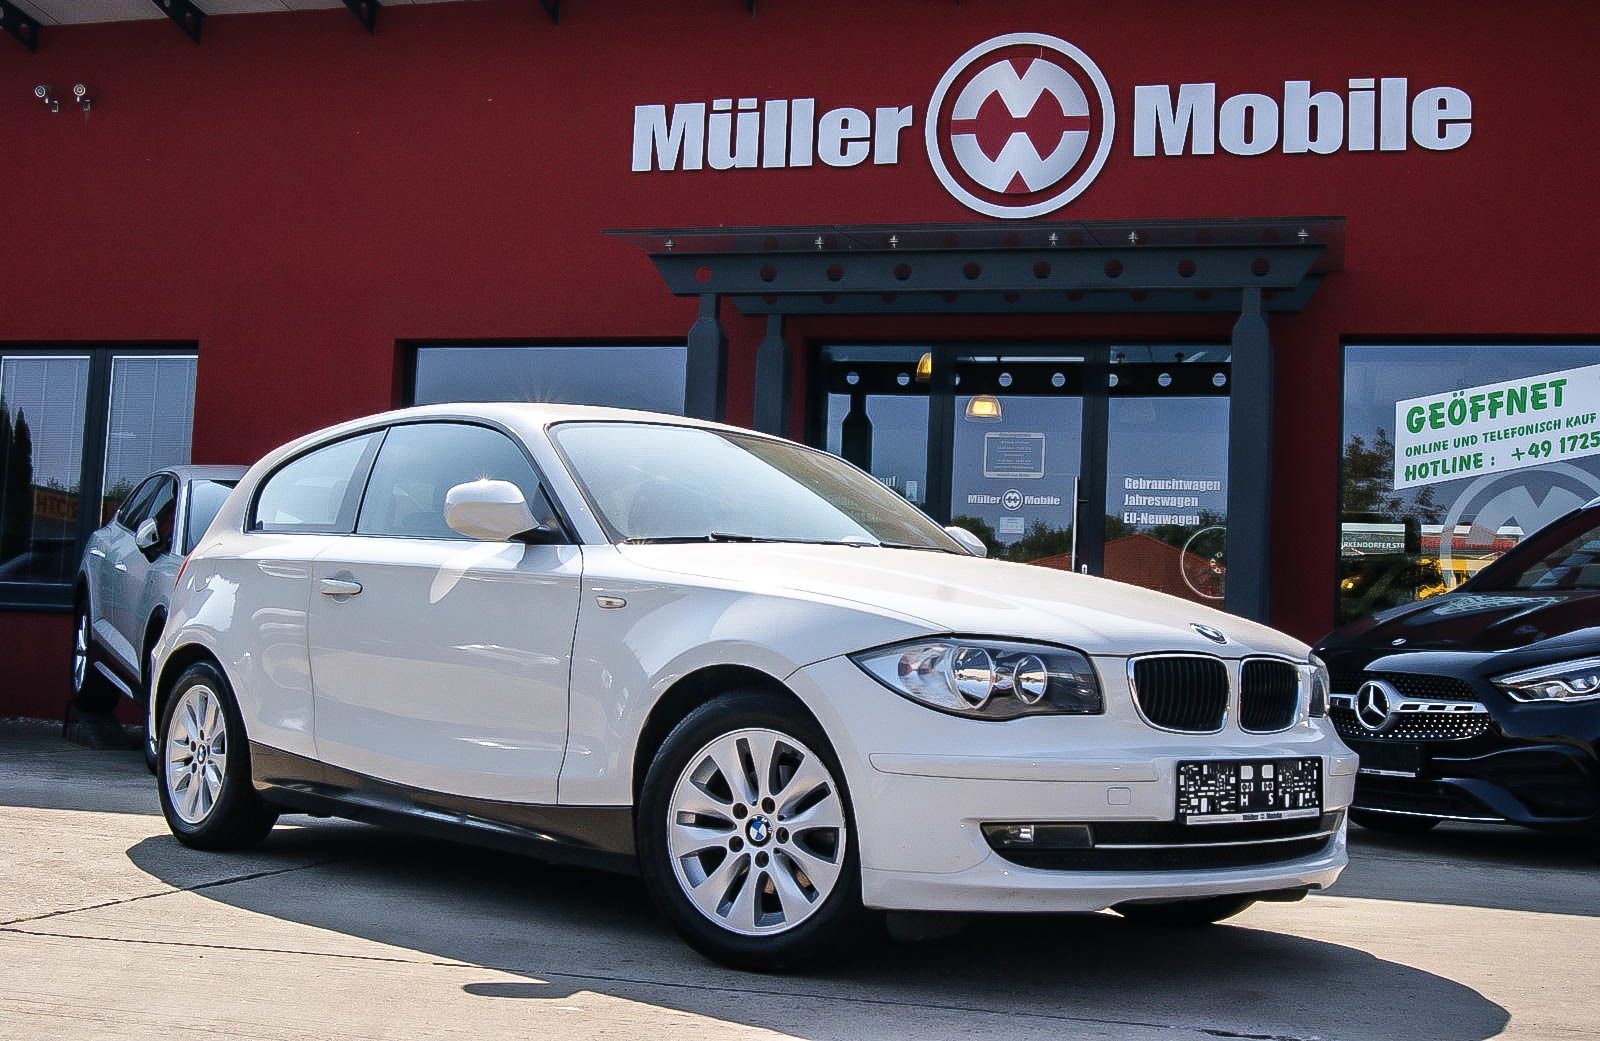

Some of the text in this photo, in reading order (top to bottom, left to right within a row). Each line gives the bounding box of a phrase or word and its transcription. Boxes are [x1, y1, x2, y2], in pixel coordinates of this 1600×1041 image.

[631, 77, 1473, 172] Müller Mobile
[1406, 378, 1567, 434] GEÖFFNET
[1405, 412, 1597, 457] ONLINE UND TELEFONISCH KAUF
[1404, 452, 1484, 482] HOTLINE
[1510, 439, 1553, 462] +49
[1124, 477, 1221, 492] Gebrauchtwagen
[967, 493, 1061, 506] Müller Mobile
[1123, 493, 1199, 508] Jahreswagen
[1123, 511, 1200, 526] EU-Neuwagen
